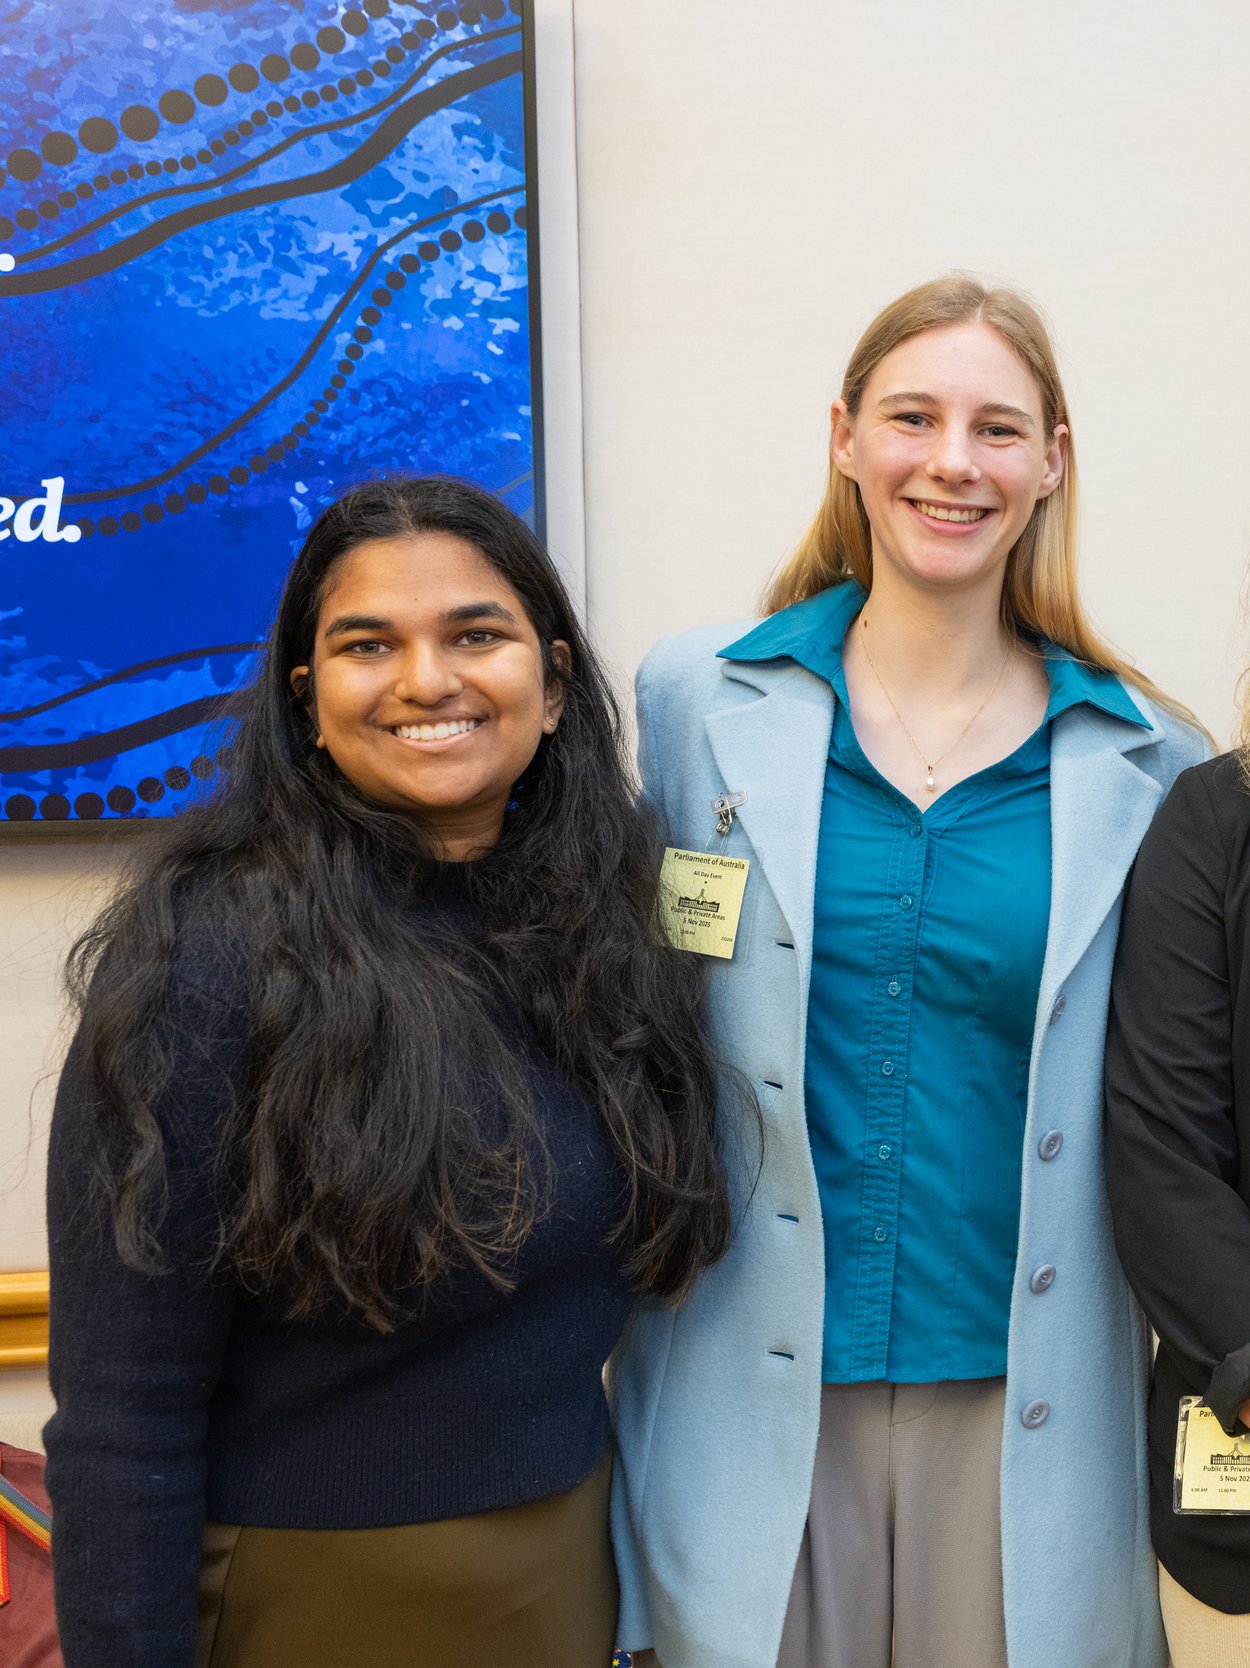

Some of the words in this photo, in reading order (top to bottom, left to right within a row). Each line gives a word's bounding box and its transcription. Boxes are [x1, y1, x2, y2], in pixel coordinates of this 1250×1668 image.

[674, 852, 710, 865] Parliament
[711, 858, 719, 866] of
[719, 859, 745, 870] Australia
[671, 905, 687, 914] Public
[693, 910, 711, 918] Private
